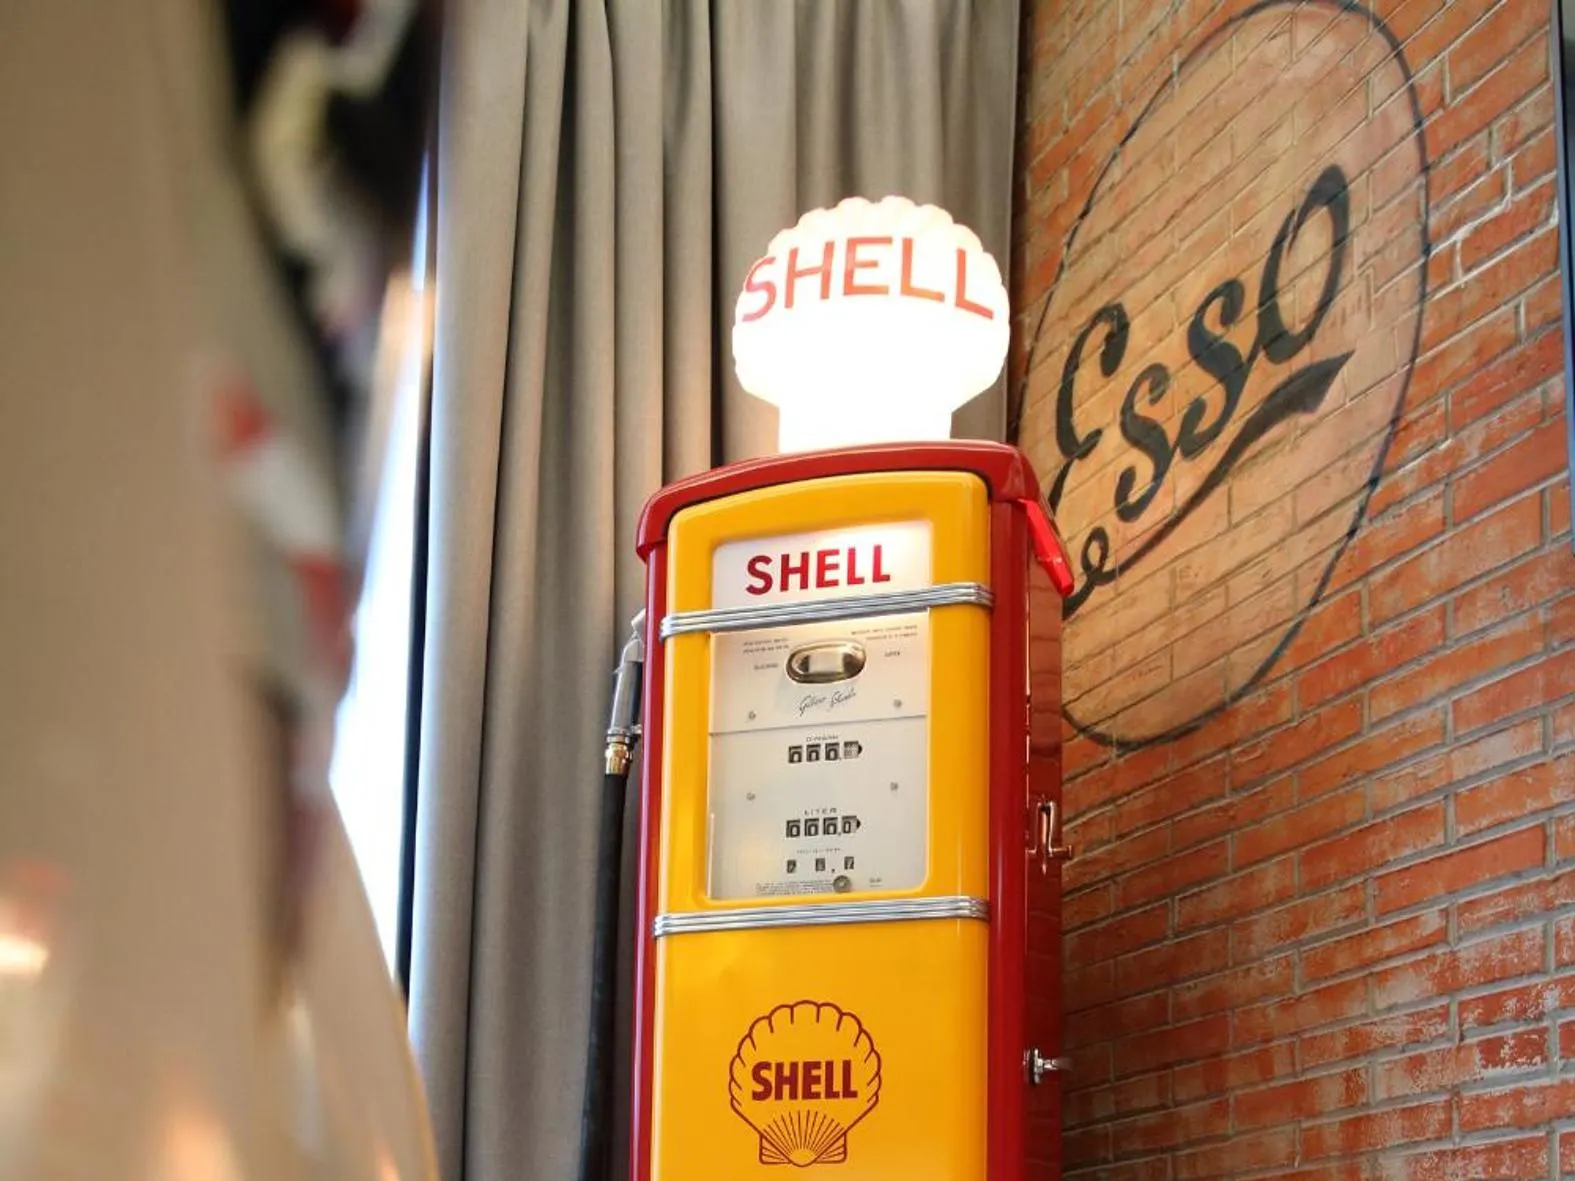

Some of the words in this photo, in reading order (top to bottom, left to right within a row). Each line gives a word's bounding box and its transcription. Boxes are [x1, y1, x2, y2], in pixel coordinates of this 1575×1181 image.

[742, 236, 994, 322] SHELL
[746, 544, 891, 596] SHELL
[752, 1059, 858, 1101] SHELL
